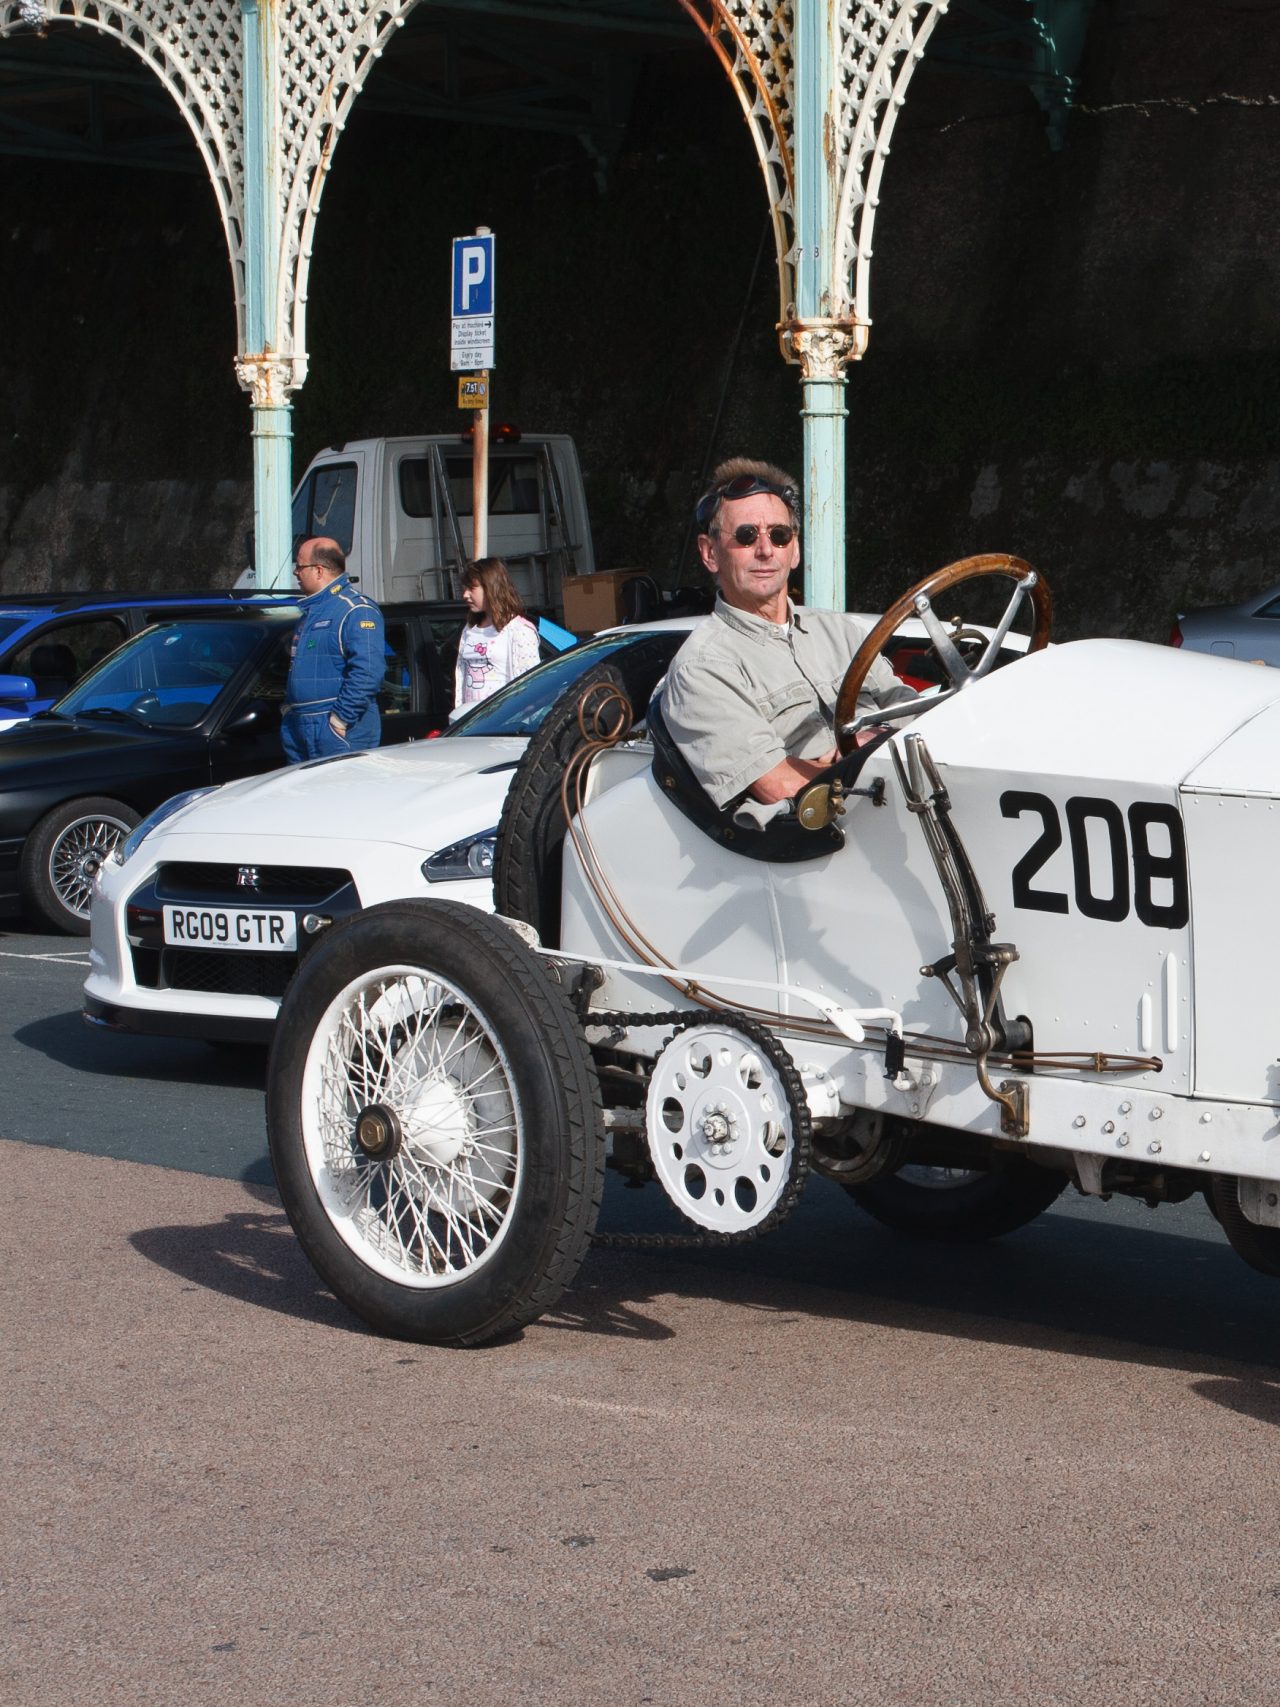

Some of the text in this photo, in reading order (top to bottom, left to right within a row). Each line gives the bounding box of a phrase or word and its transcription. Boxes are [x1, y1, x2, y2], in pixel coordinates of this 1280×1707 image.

[462, 246, 486, 310] P
[999, 789, 1190, 930] 208
[172, 909, 285, 944] RG09 GTR
